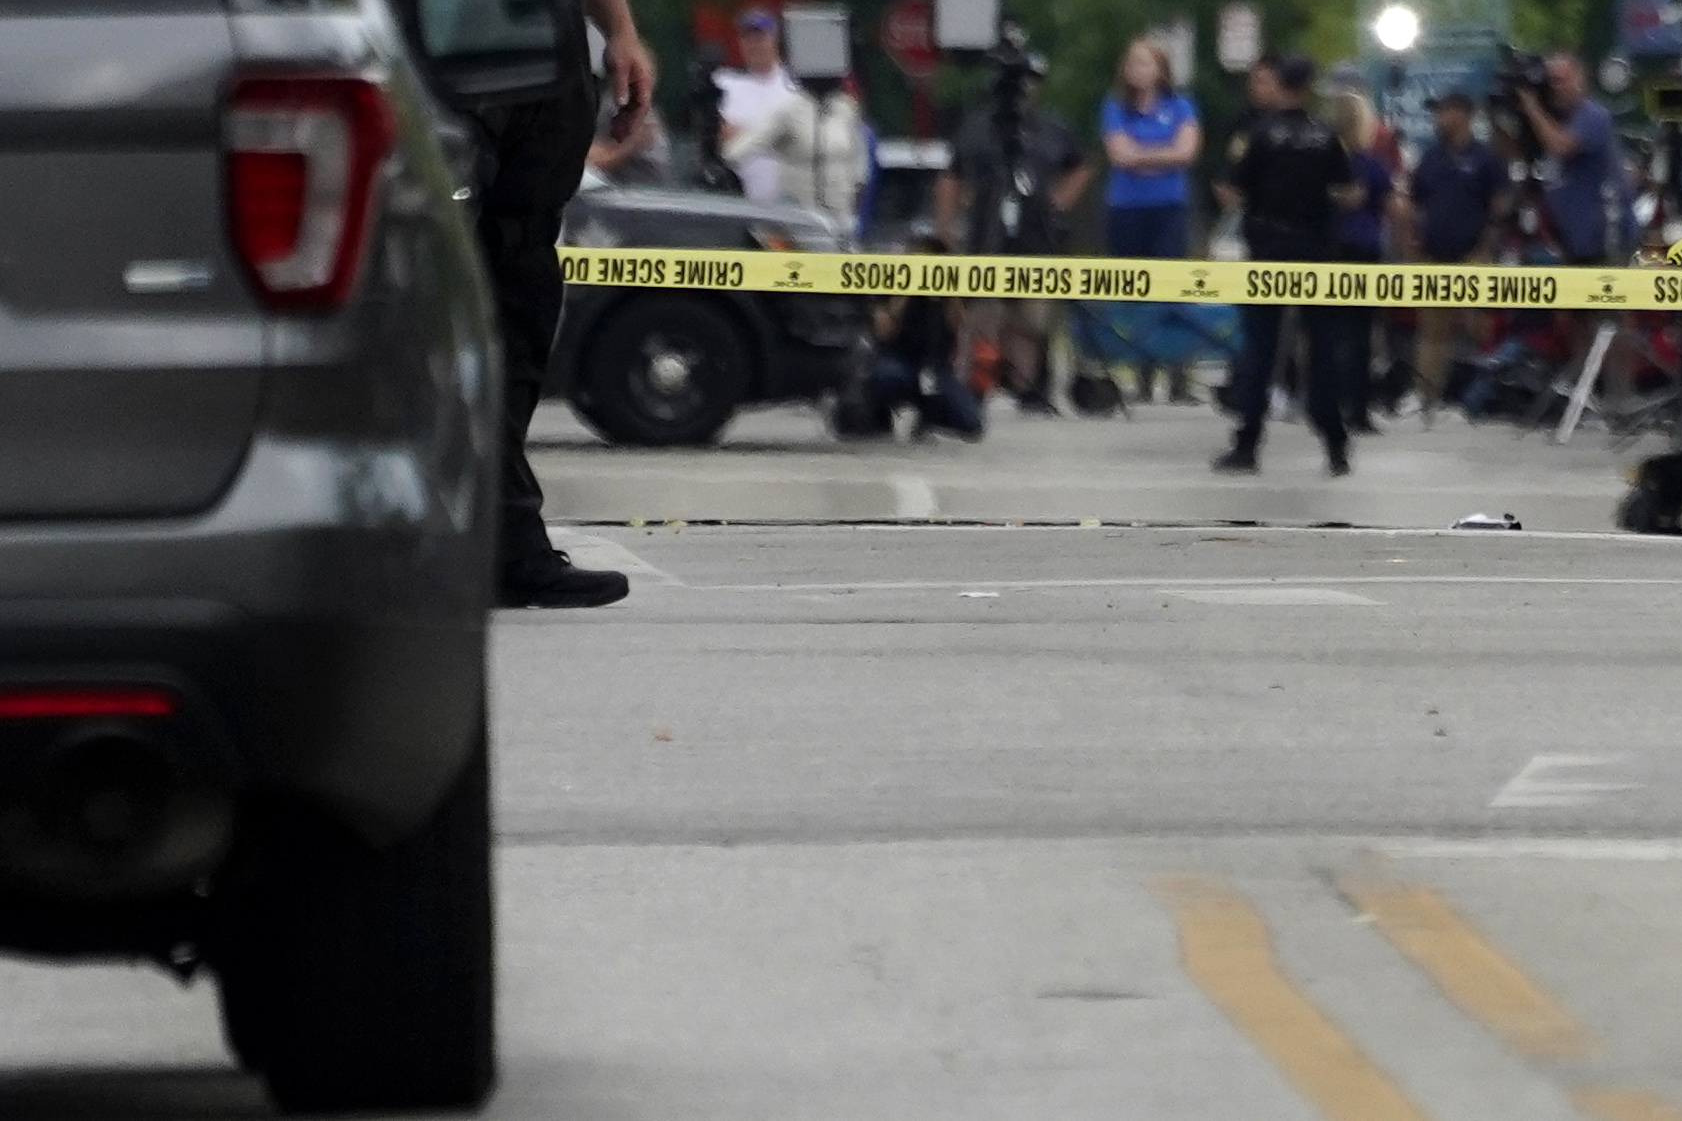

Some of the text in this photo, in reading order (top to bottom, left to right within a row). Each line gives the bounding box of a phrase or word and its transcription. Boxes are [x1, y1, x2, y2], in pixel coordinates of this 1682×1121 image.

[562, 256, 744, 287] CRIME SCENE DO
[840, 261, 1151, 298] CRIME SCENE DO NOT CROSS
[1246, 269, 1557, 305] CRIME SCENE DO NOT CROSS
